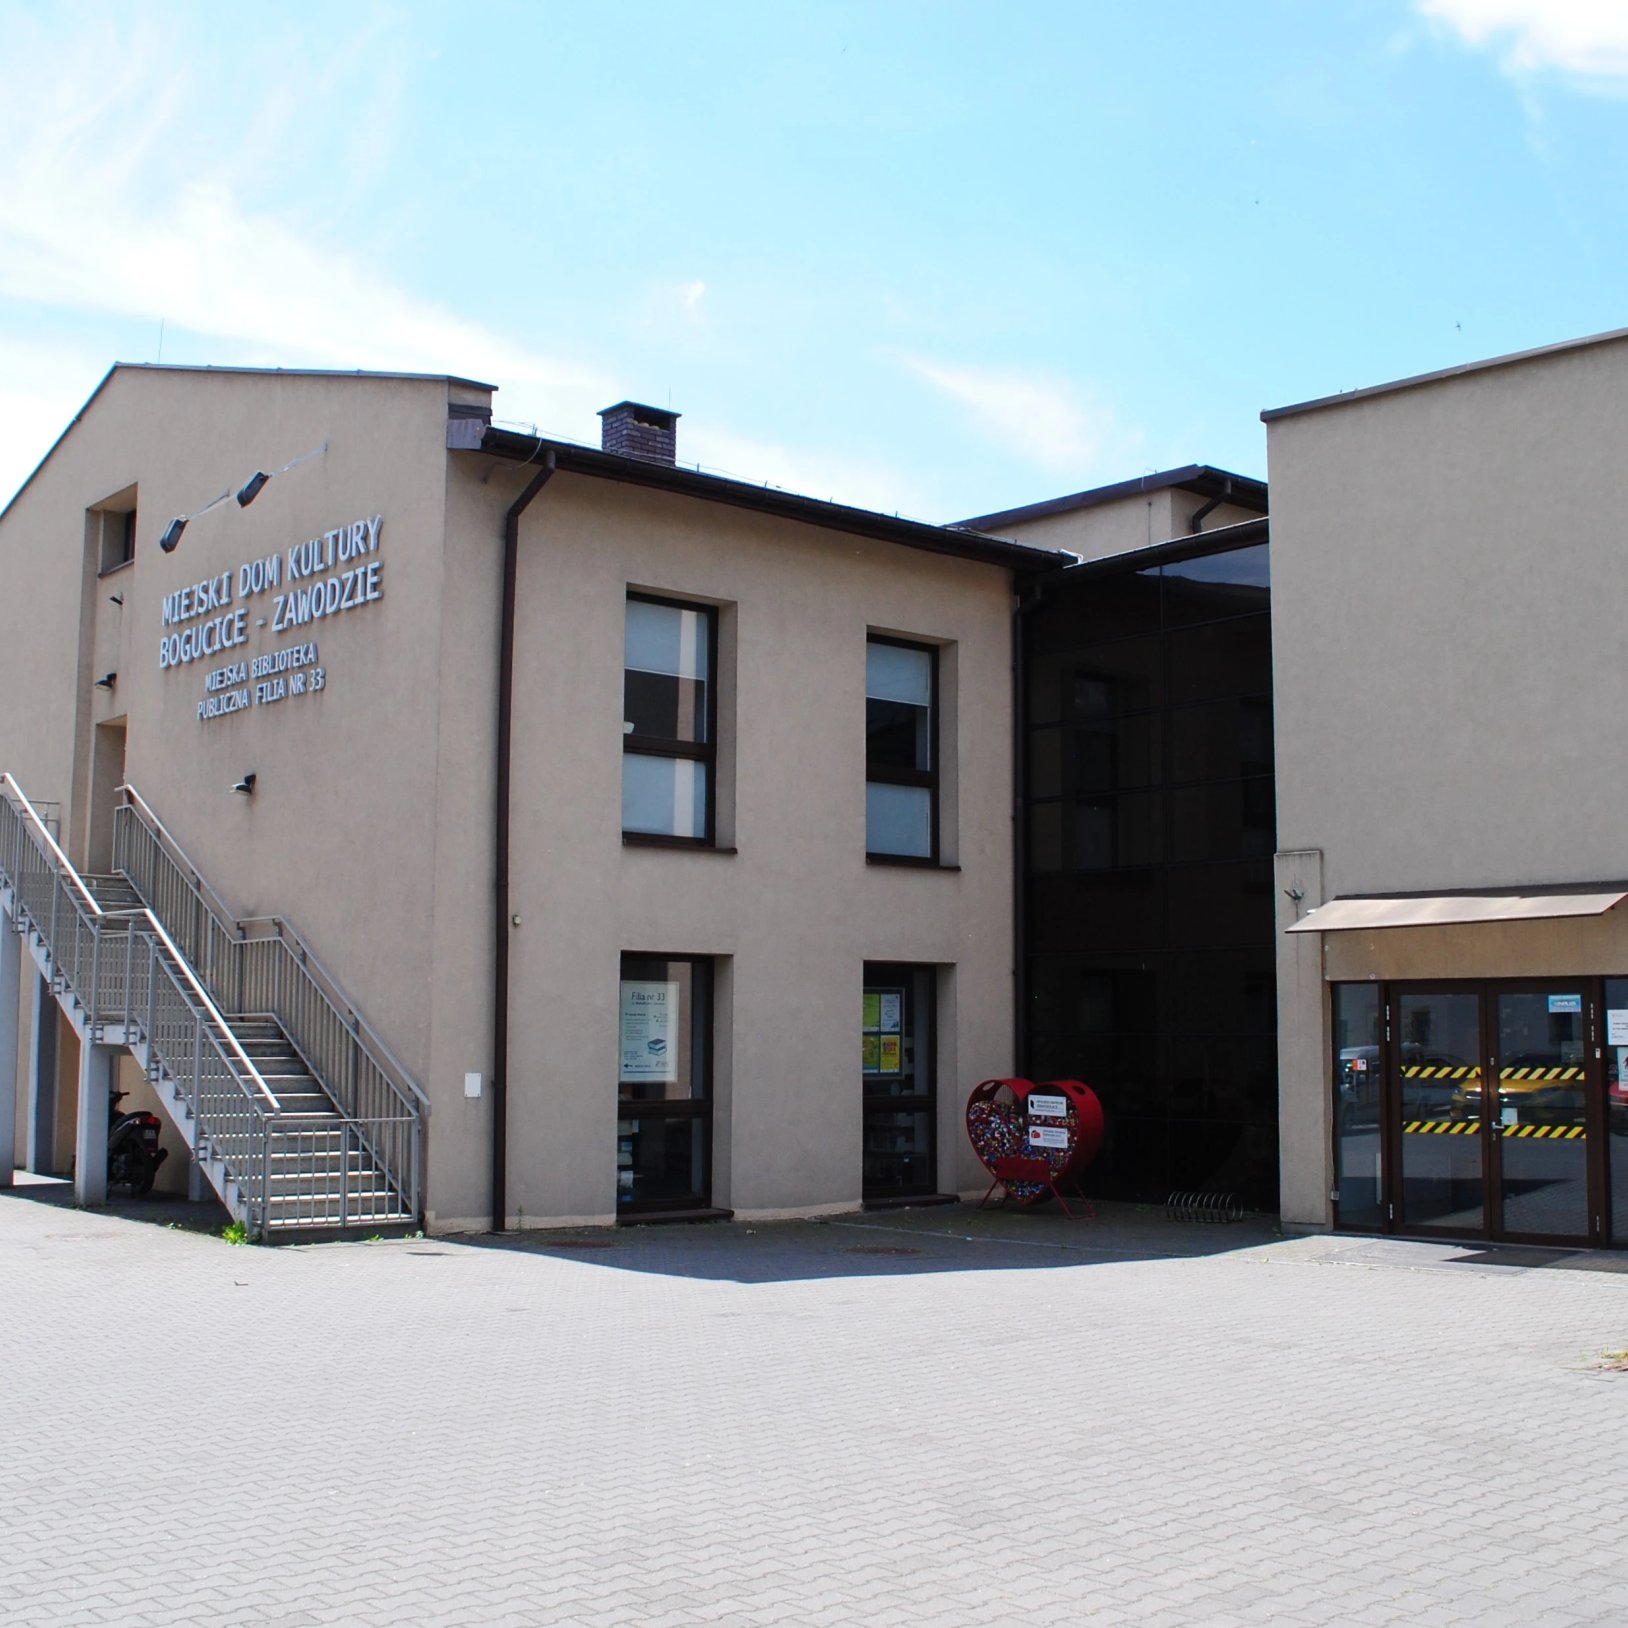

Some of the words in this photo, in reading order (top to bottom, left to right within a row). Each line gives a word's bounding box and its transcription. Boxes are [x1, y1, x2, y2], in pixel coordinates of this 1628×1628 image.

[162, 571, 232, 626] MIEJSKI
[239, 553, 281, 597] DOM
[288, 514, 383, 580] KULTURY
[160, 608, 248, 669] BOGUCICE
[272, 561, 383, 632] ZAWODZIE
[197, 689, 250, 720] PUBLICZNA
[256, 678, 285, 704] FILIA
[289, 674, 305, 694] NR
[309, 667, 325, 691] 33
[205, 662, 248, 692] MIEJSKA
[251, 643, 317, 678] BIBLIOTEKA
[631, 991, 646, 1001] Filia
[656, 991, 665, 1001] 33
